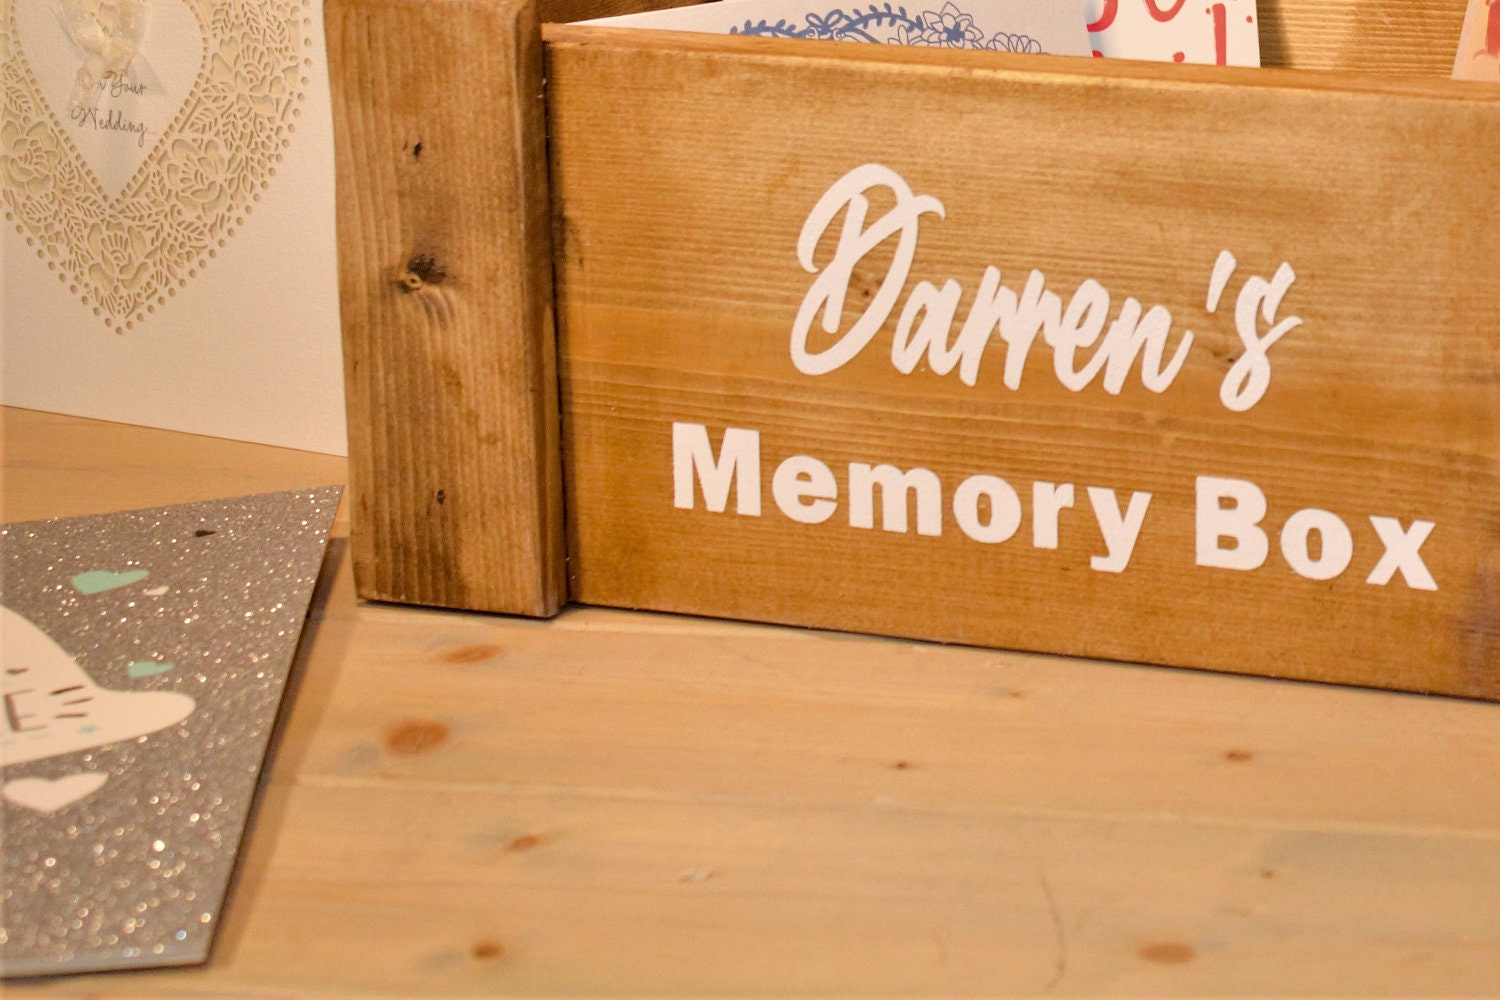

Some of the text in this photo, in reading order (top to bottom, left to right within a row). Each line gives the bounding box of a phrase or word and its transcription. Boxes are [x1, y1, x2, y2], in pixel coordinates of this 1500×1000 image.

[104, 70, 147, 98] Your
[789, 162, 1304, 413] Darren's
[671, 421, 1439, 592] Memory Box
